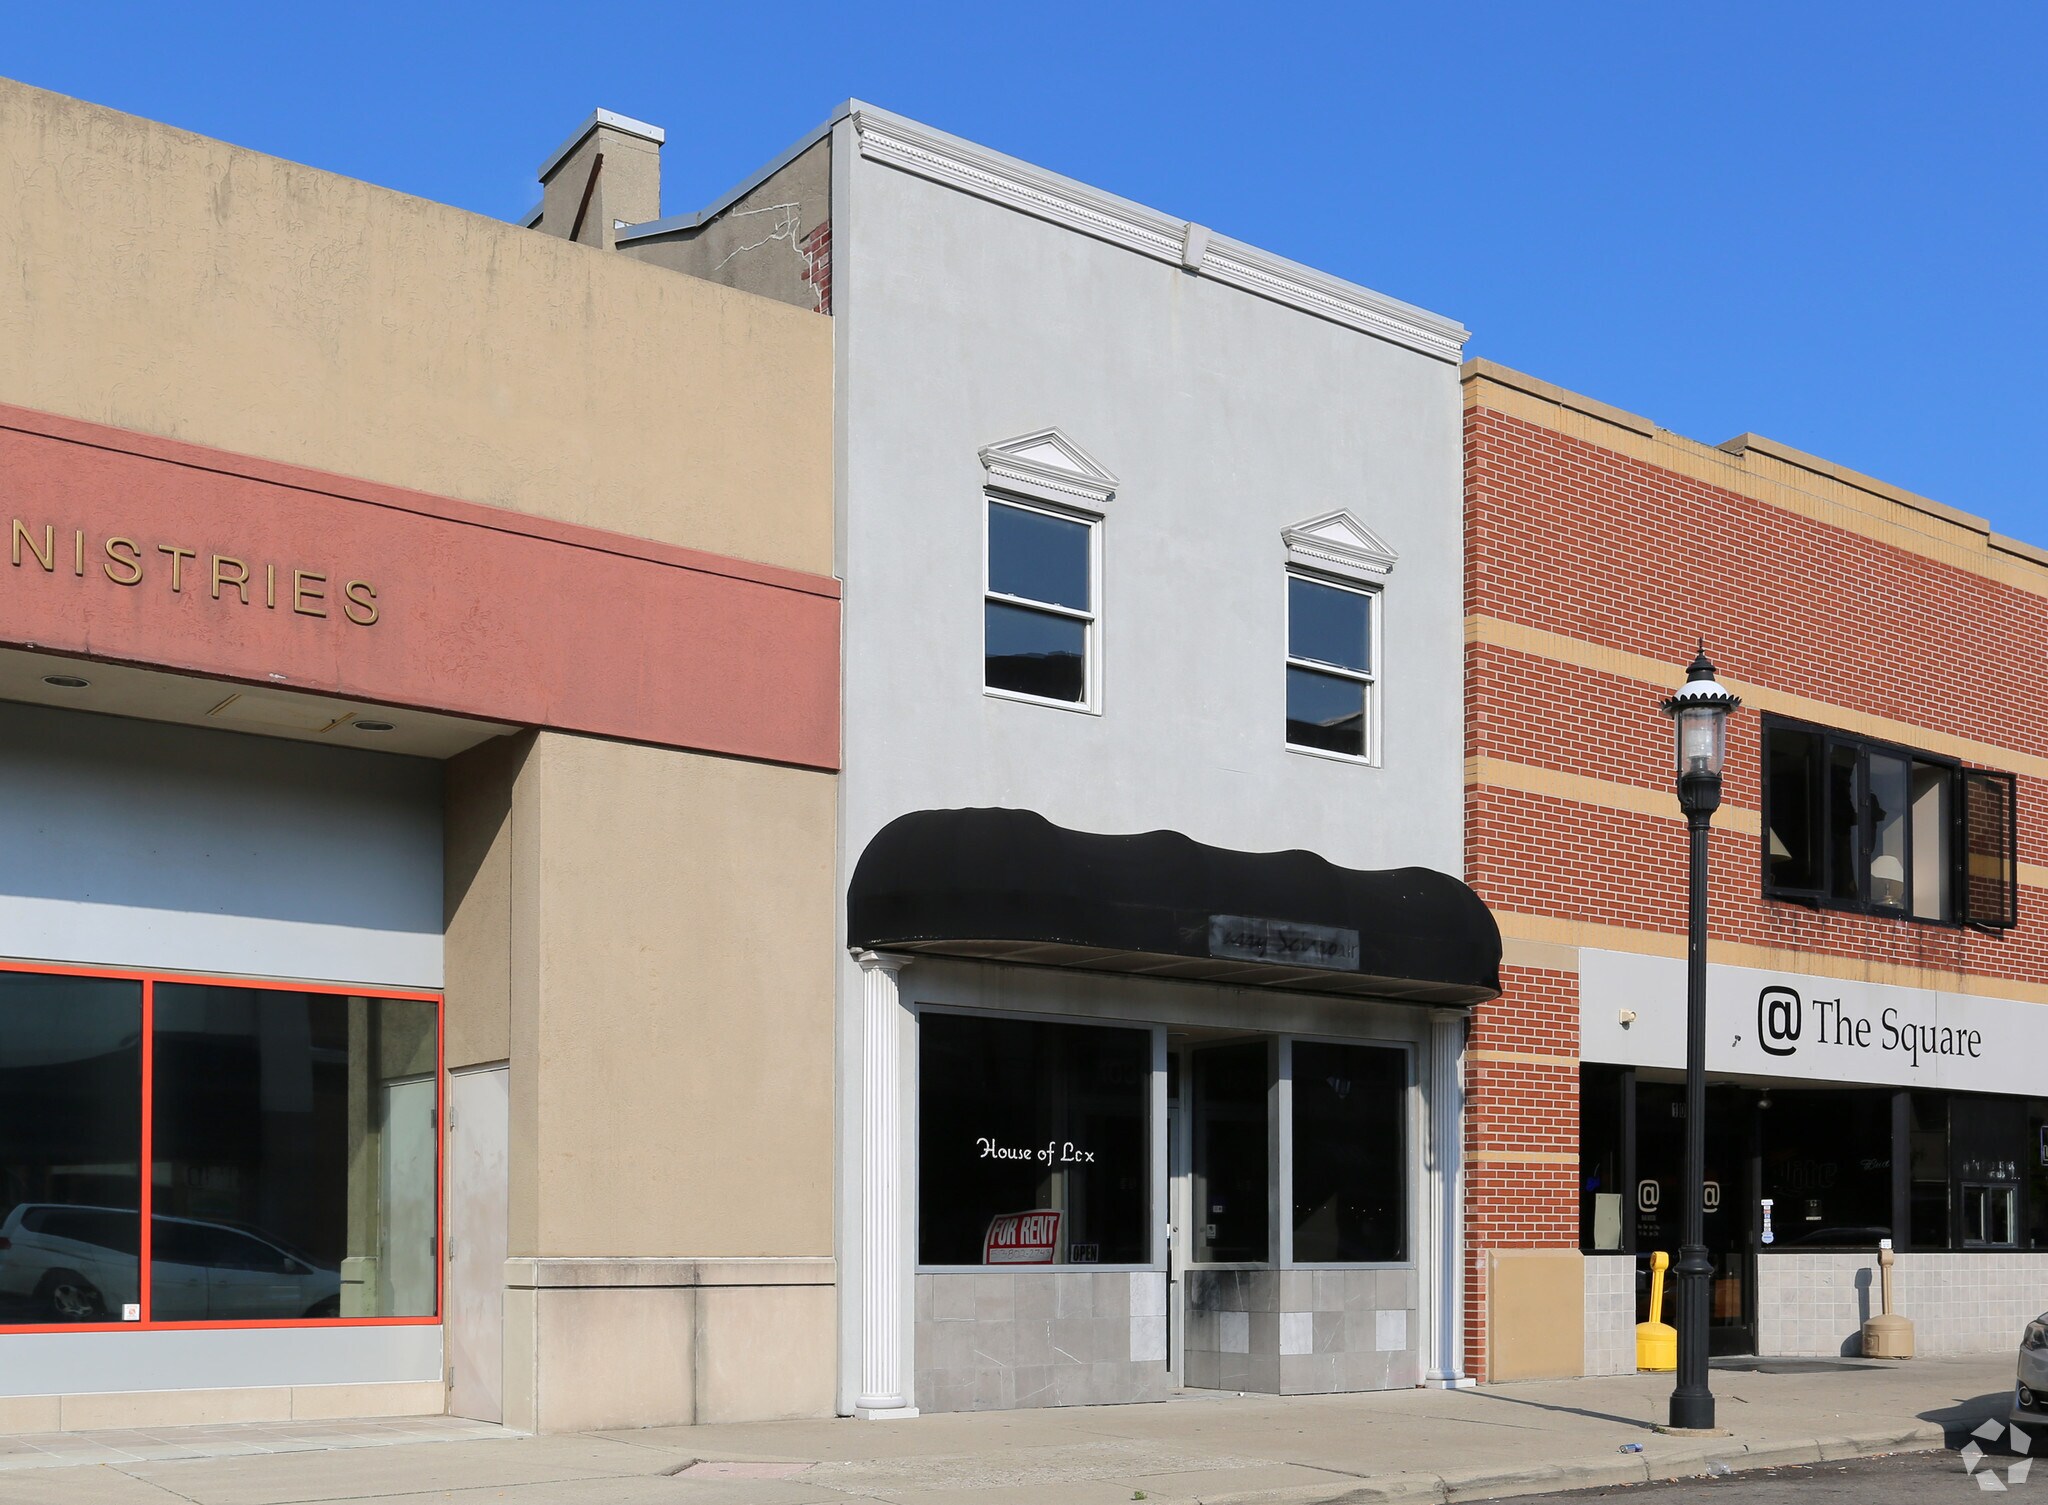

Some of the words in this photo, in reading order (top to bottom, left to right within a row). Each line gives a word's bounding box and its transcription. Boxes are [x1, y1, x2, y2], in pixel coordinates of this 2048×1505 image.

[12, 518, 380, 626] NISTRIES
[1758, 985, 1801, 1056] @
[1812, 998, 1871, 1048] The
[1881, 1007, 1982, 1067] Square
[976, 1137, 1032, 1160] House
[1037, 1141, 1056, 1166] of
[1638, 1179, 1660, 1212] @
[990, 1217, 1018, 1246] FOR
[1020, 1215, 1057, 1245] RENT
[1073, 1246, 1097, 1261] OPEN
